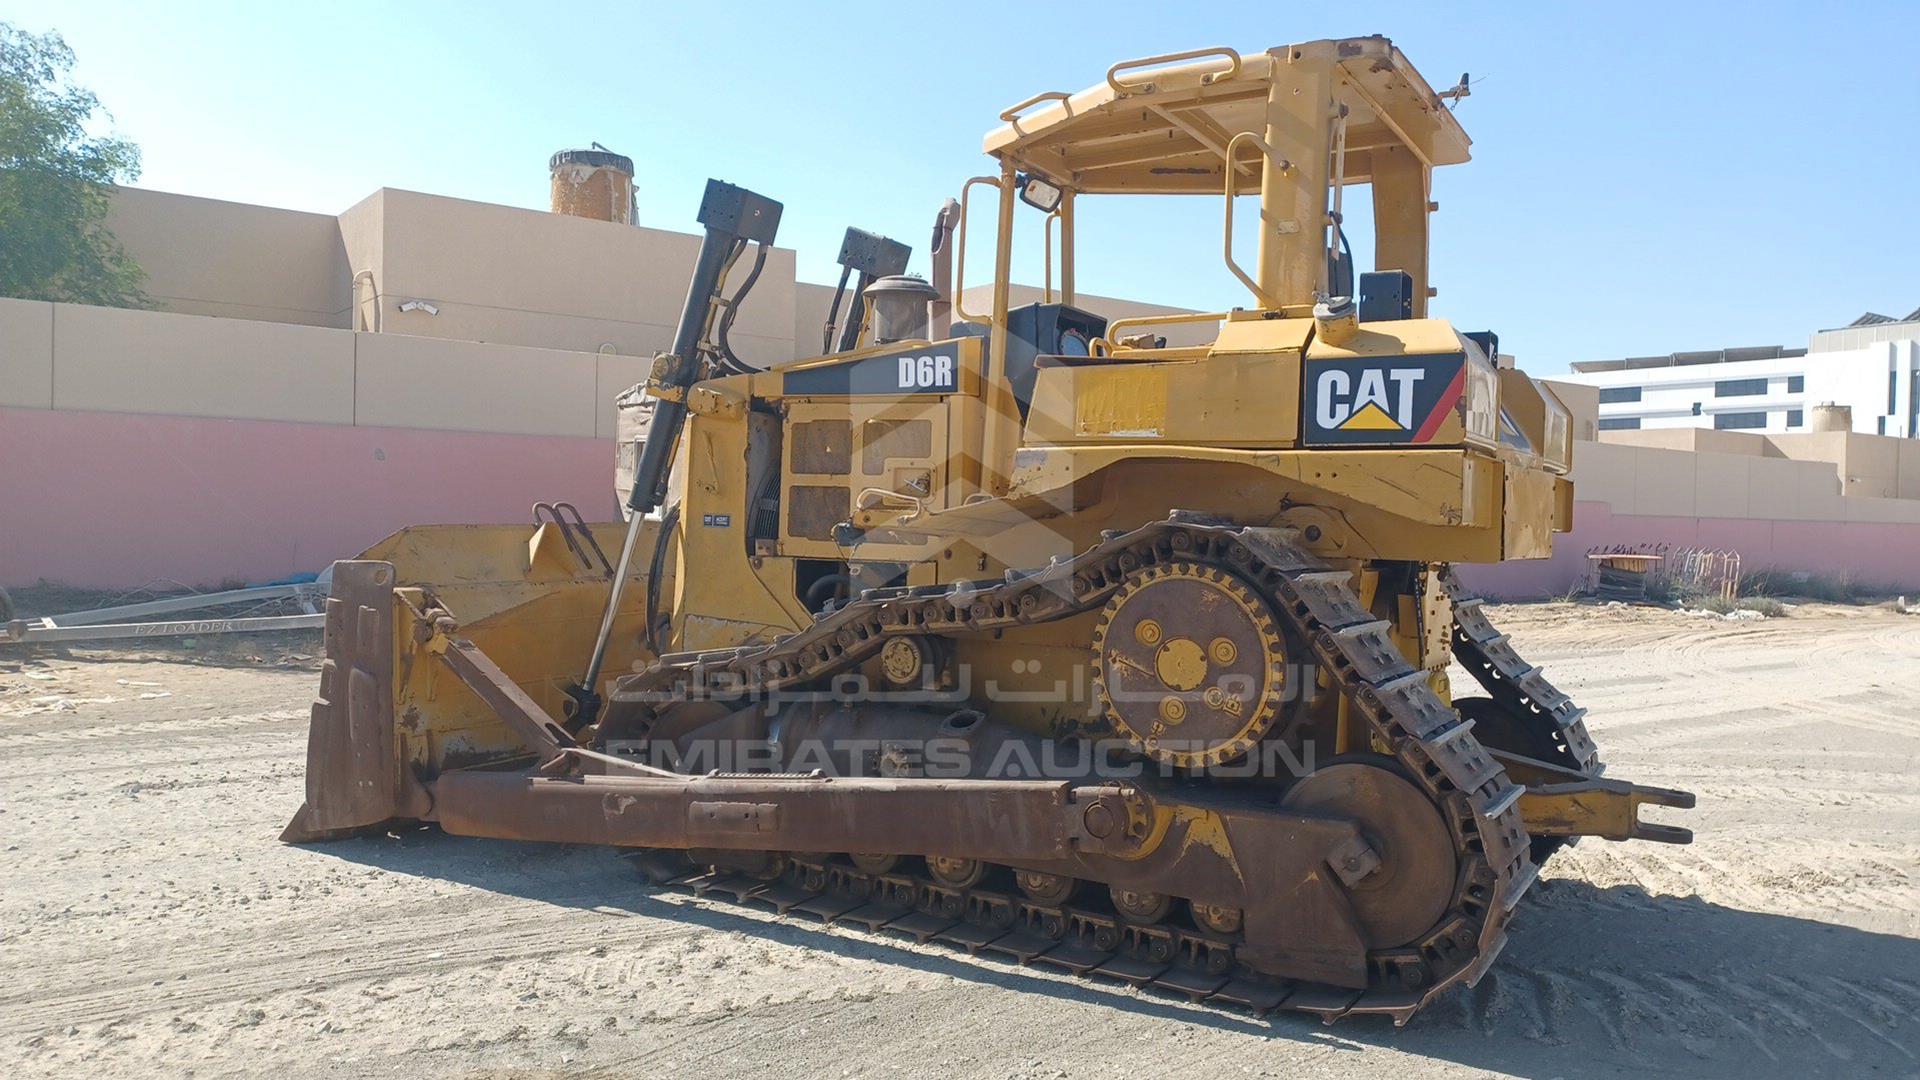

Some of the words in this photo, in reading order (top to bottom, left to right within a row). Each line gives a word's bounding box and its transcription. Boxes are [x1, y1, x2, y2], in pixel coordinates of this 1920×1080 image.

[898, 355, 952, 388] D6R
[1316, 368, 1425, 431] CAT
[163, 621, 233, 633] LOADER
